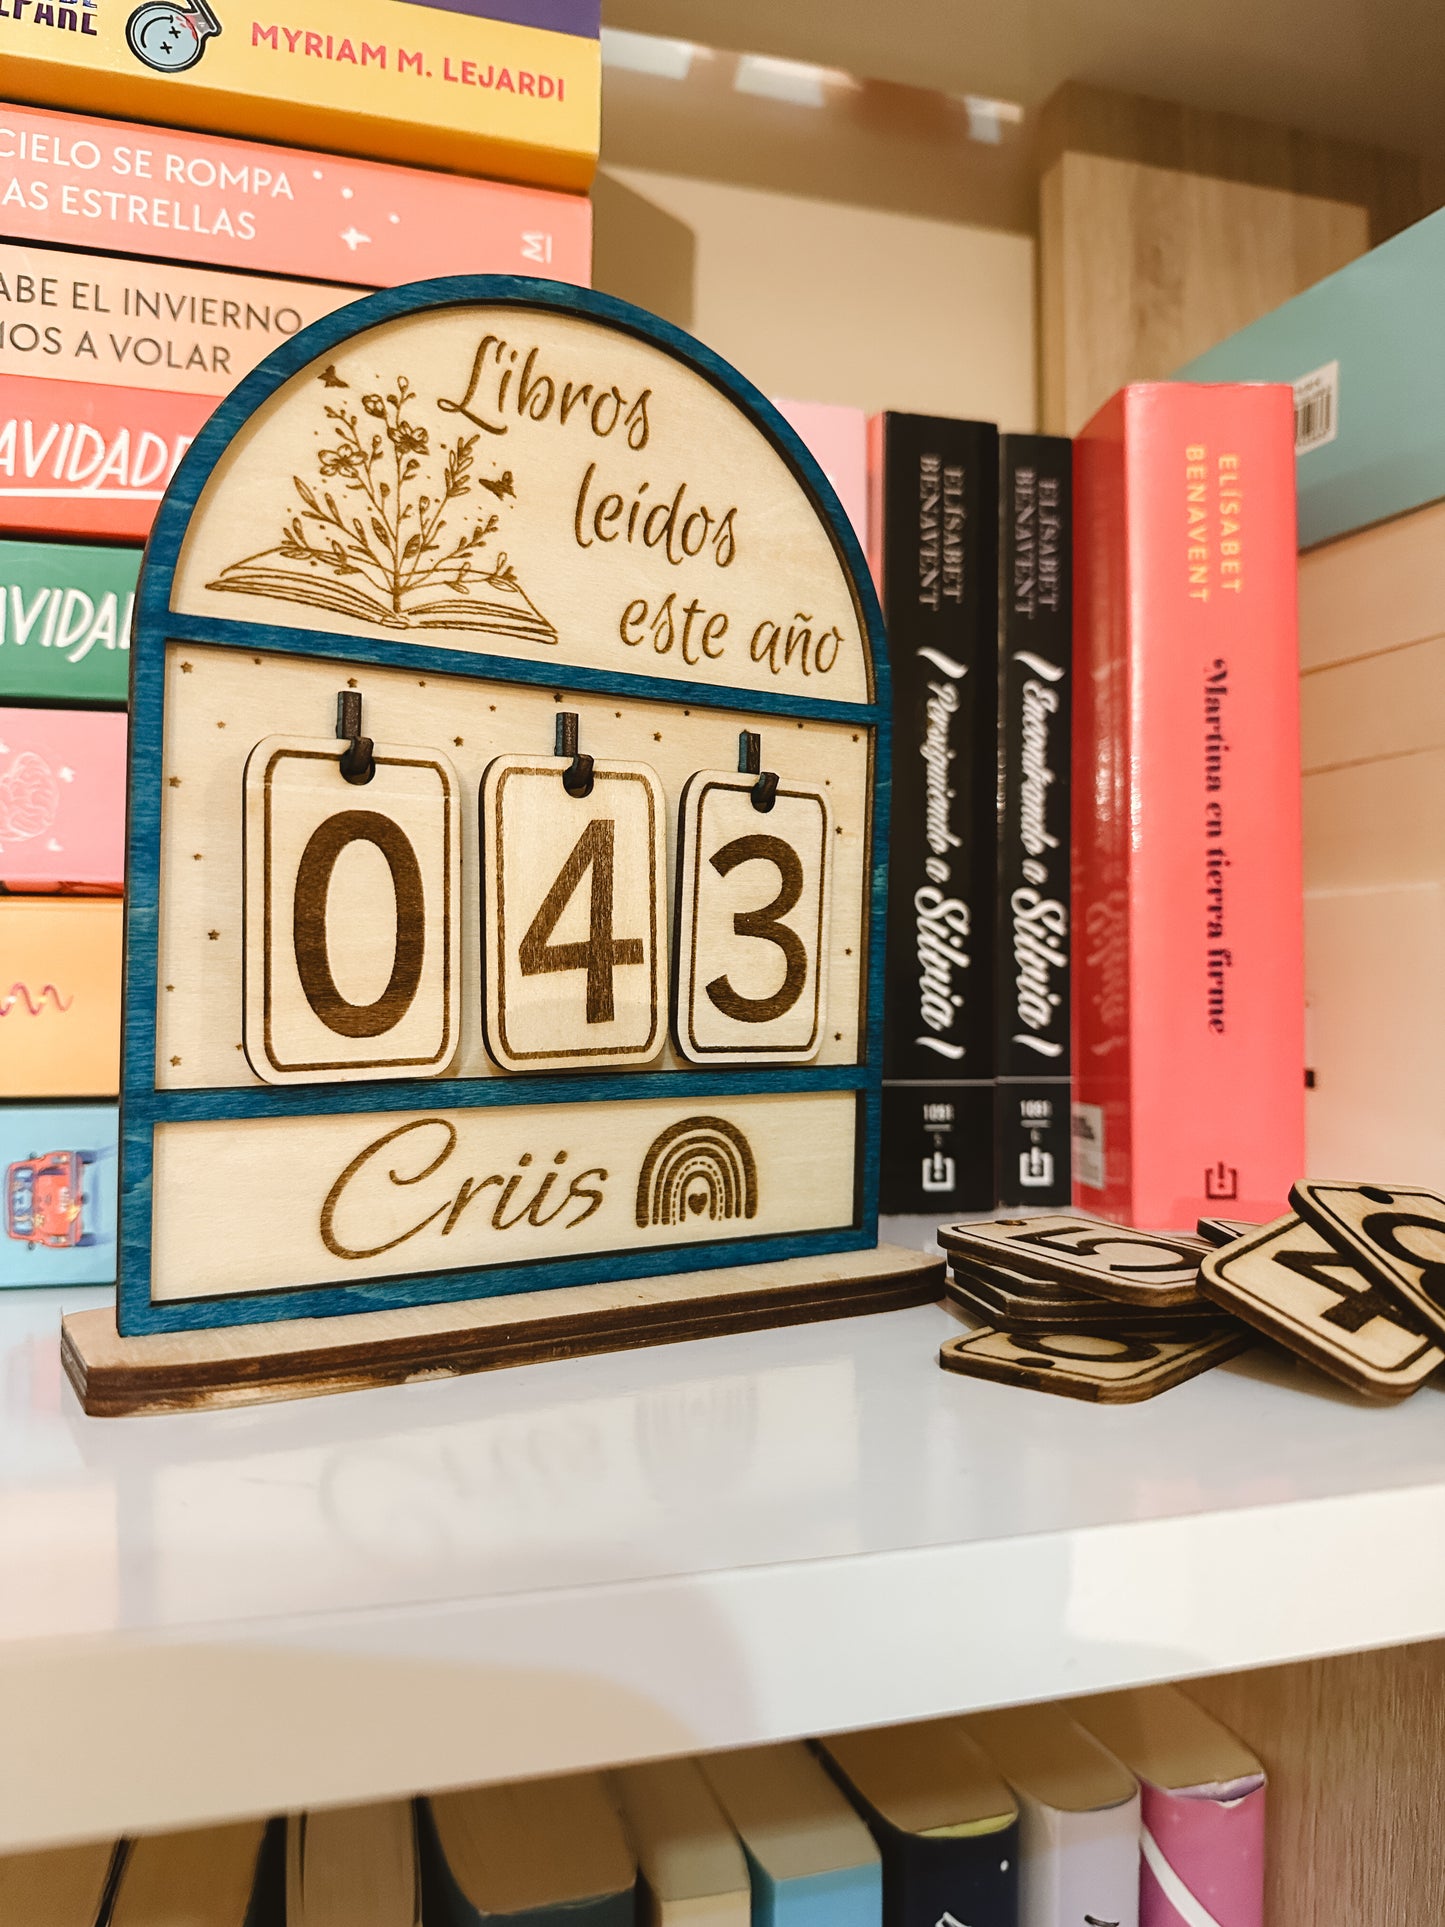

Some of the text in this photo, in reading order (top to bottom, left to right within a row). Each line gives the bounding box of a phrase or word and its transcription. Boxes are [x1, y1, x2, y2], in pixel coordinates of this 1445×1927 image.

[252, 22, 565, 102] MYRIAM M. LEJARDI
[61, 185, 257, 240] ESTRELLAS
[111, 146, 153, 179] SE
[165, 153, 295, 201] ROMPA
[0, 320, 232, 375] OS A VOLAR
[72, 281, 111, 313] EL
[123, 288, 303, 336] INVIERNO
[437, 335, 653, 451] Libros
[574, 463, 738, 568] leídos
[919, 453, 942, 611] BENAVENT
[1014, 466, 1037, 619] BENAVENT
[1185, 444, 1209, 602] BENAVENT
[0, 585, 136, 663] VIDA
[619, 592, 845, 677] este año
[926, 856, 951, 884] a
[1022, 858, 1049, 886] a
[1205, 658, 1232, 1035] Martina en tierra firme
[914, 885, 971, 1031] Silvia
[1010, 886, 1068, 1030] Silvia
[320, 1117, 609, 1260] Criis
